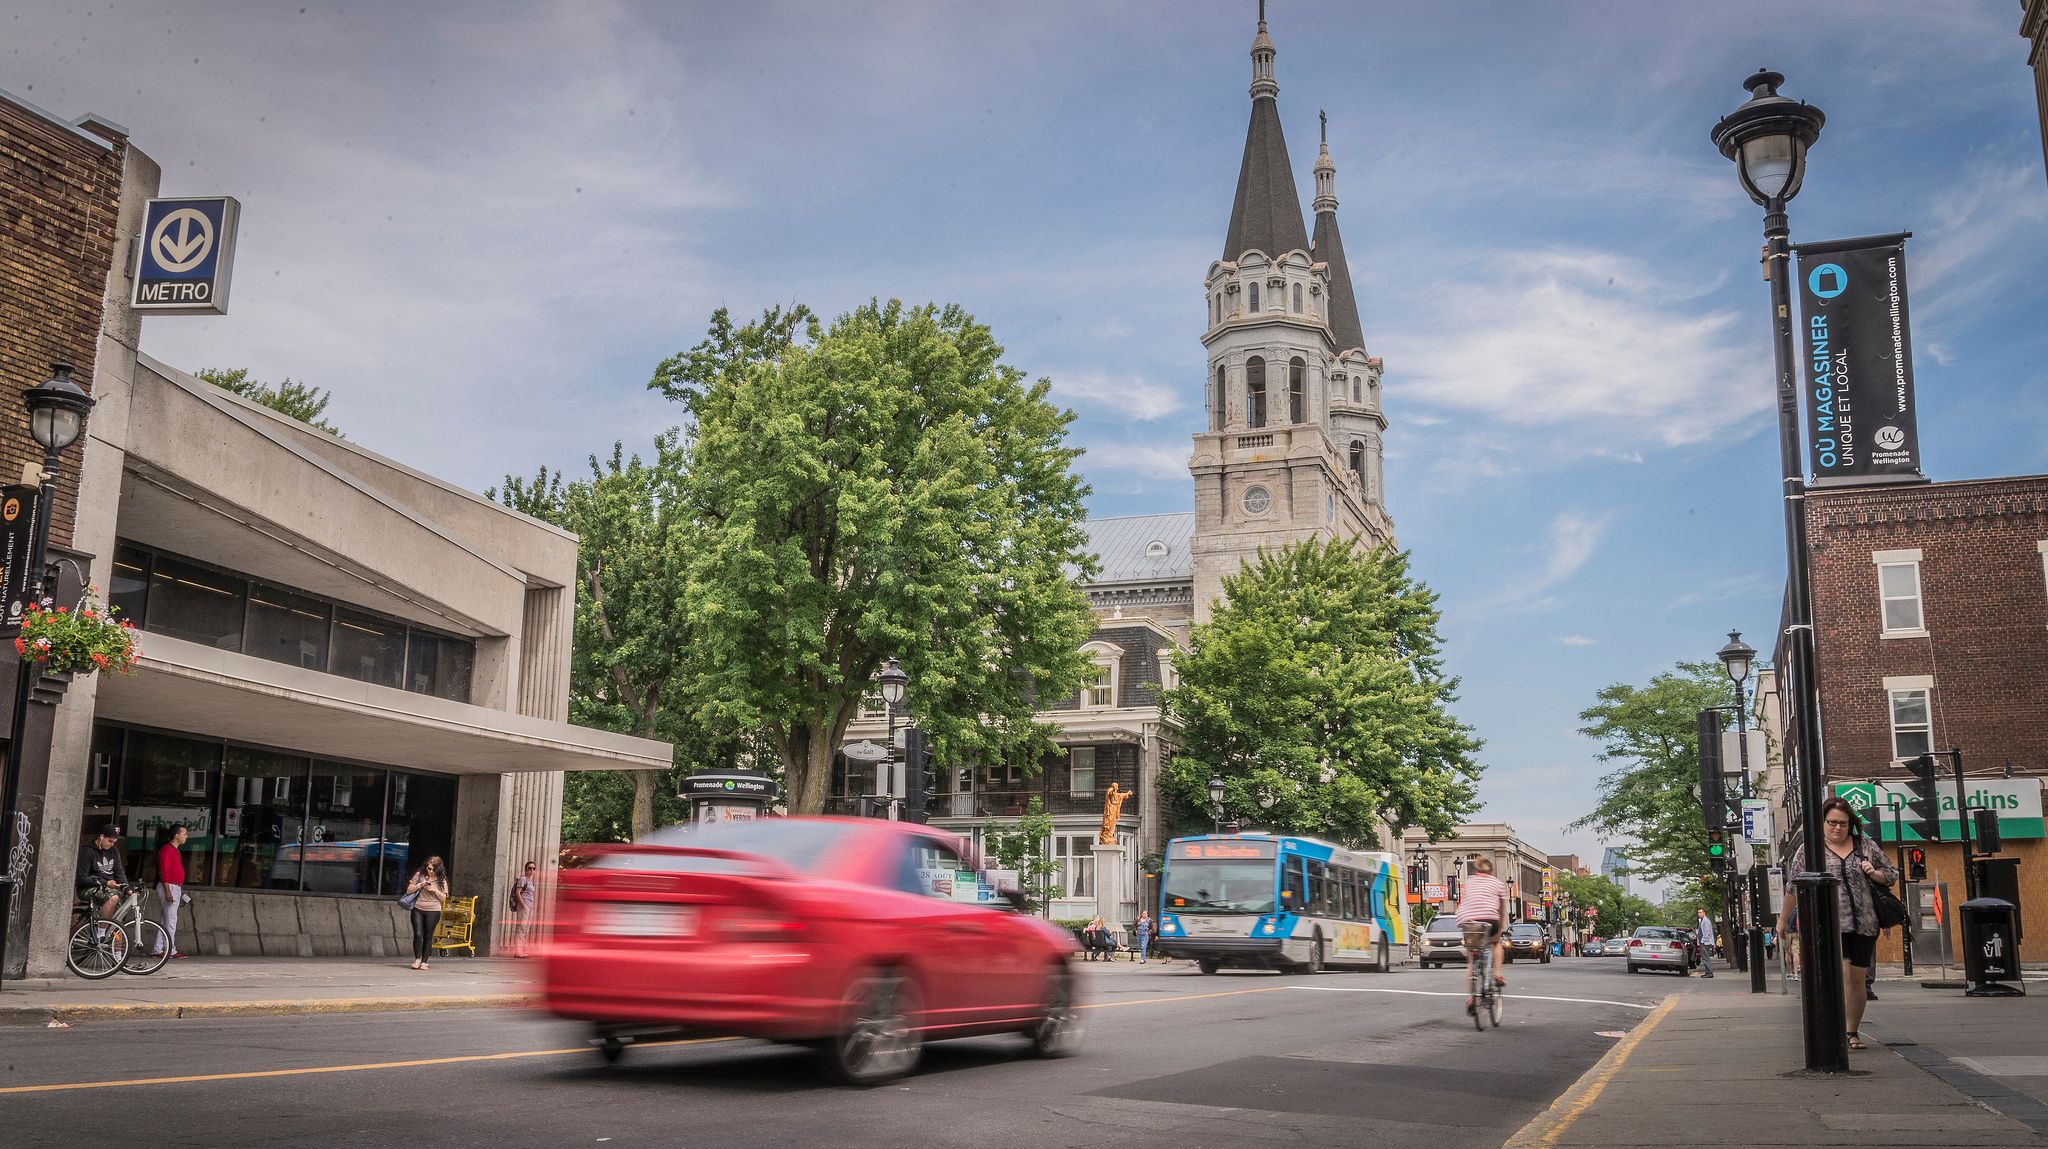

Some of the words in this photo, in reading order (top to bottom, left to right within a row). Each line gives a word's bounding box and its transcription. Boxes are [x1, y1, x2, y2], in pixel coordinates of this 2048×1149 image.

[141, 281, 209, 301] MÉTRO
[1887, 257, 1907, 413] www.promenadewellington.com
[1811, 314, 1835, 430] MAGASINER
[1835, 348, 1849, 392] LOCAL
[1838, 395, 1851, 411] ET
[1815, 439, 1837, 468] OÙ
[1842, 415, 1855, 467] UNIQUE
[1871, 450, 1910, 458] Promenade
[1872, 457, 1910, 465] Wellington
[2, 531, 15, 602] NATURELLEMENT
[736, 782, 765, 791] Wellington
[1887, 789, 2019, 815] Djadins
[920, 871, 931, 879] 28
